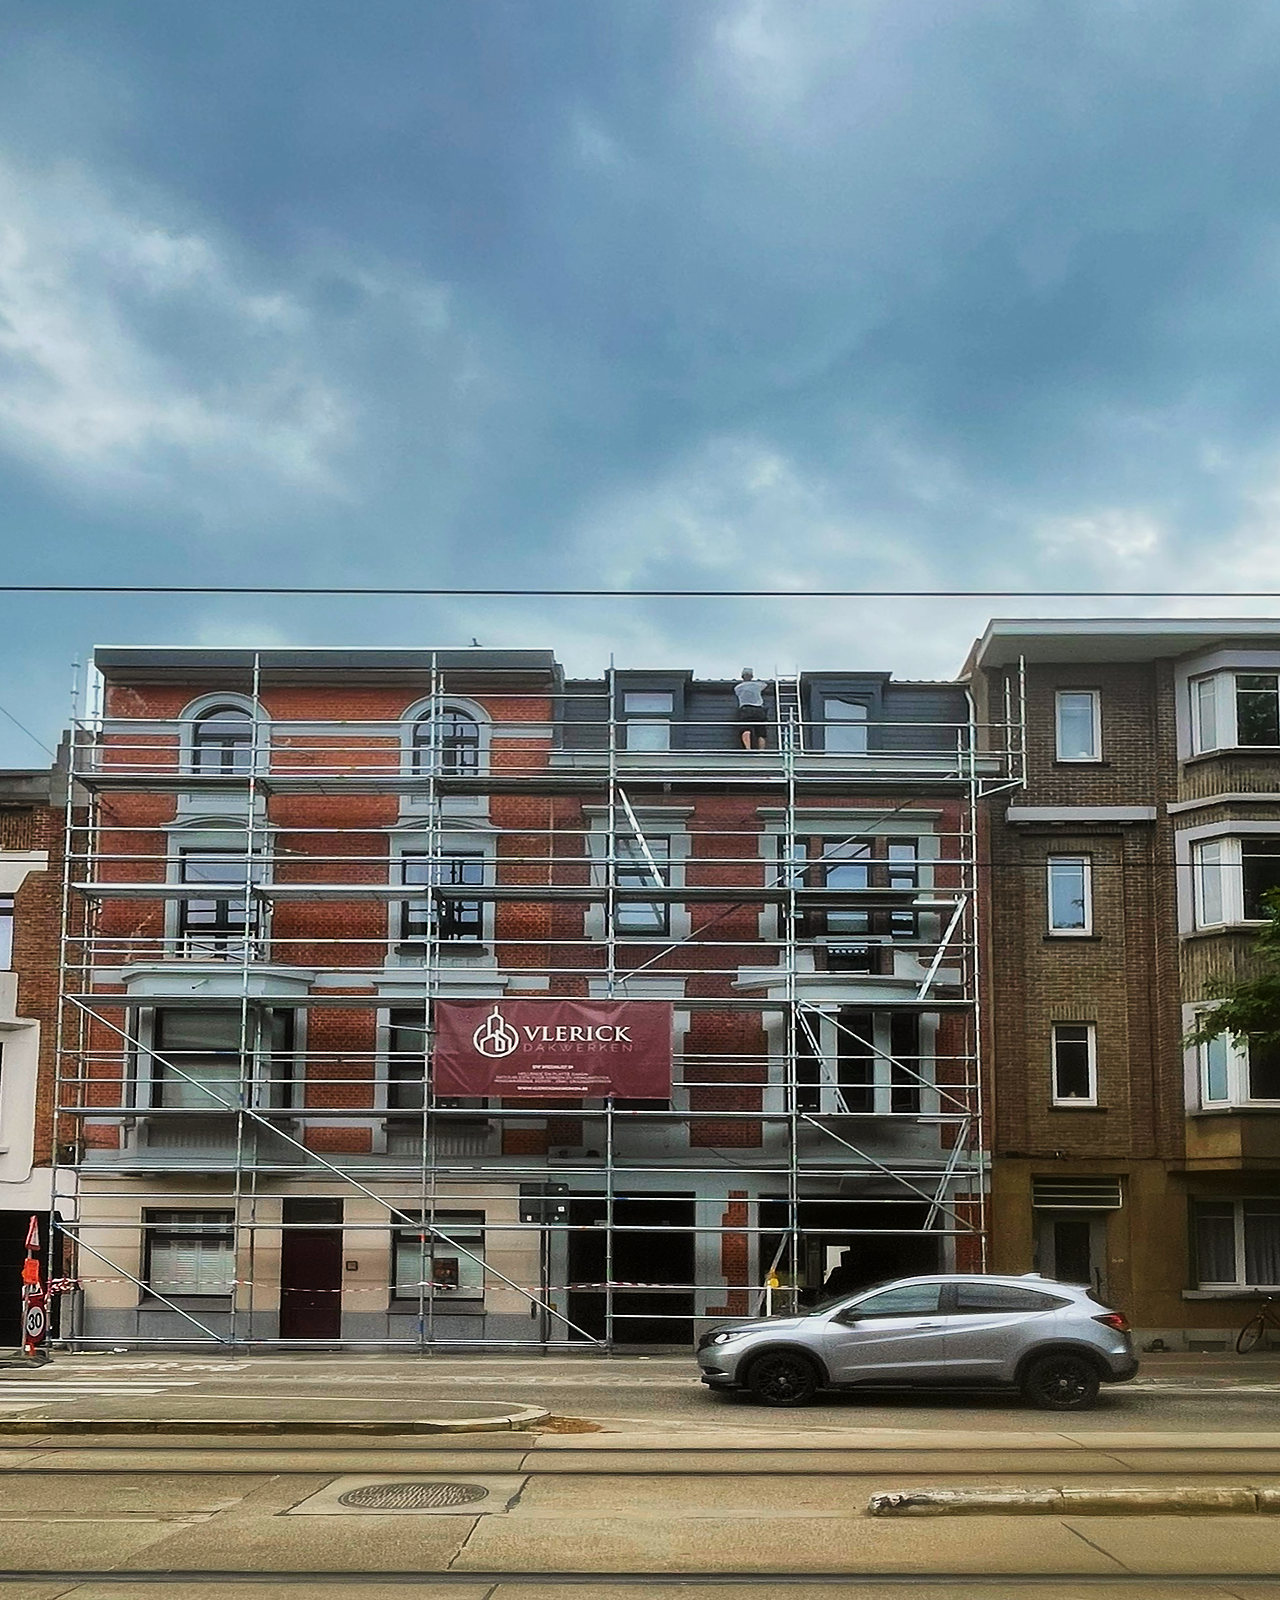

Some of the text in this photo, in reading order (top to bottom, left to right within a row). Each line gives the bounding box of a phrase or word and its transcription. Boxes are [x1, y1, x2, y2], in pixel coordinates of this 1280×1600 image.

[523, 1025, 632, 1042] VLERICK
[523, 1043, 633, 1053] DAKWERKEN
[28, 1313, 42, 1330] 30
